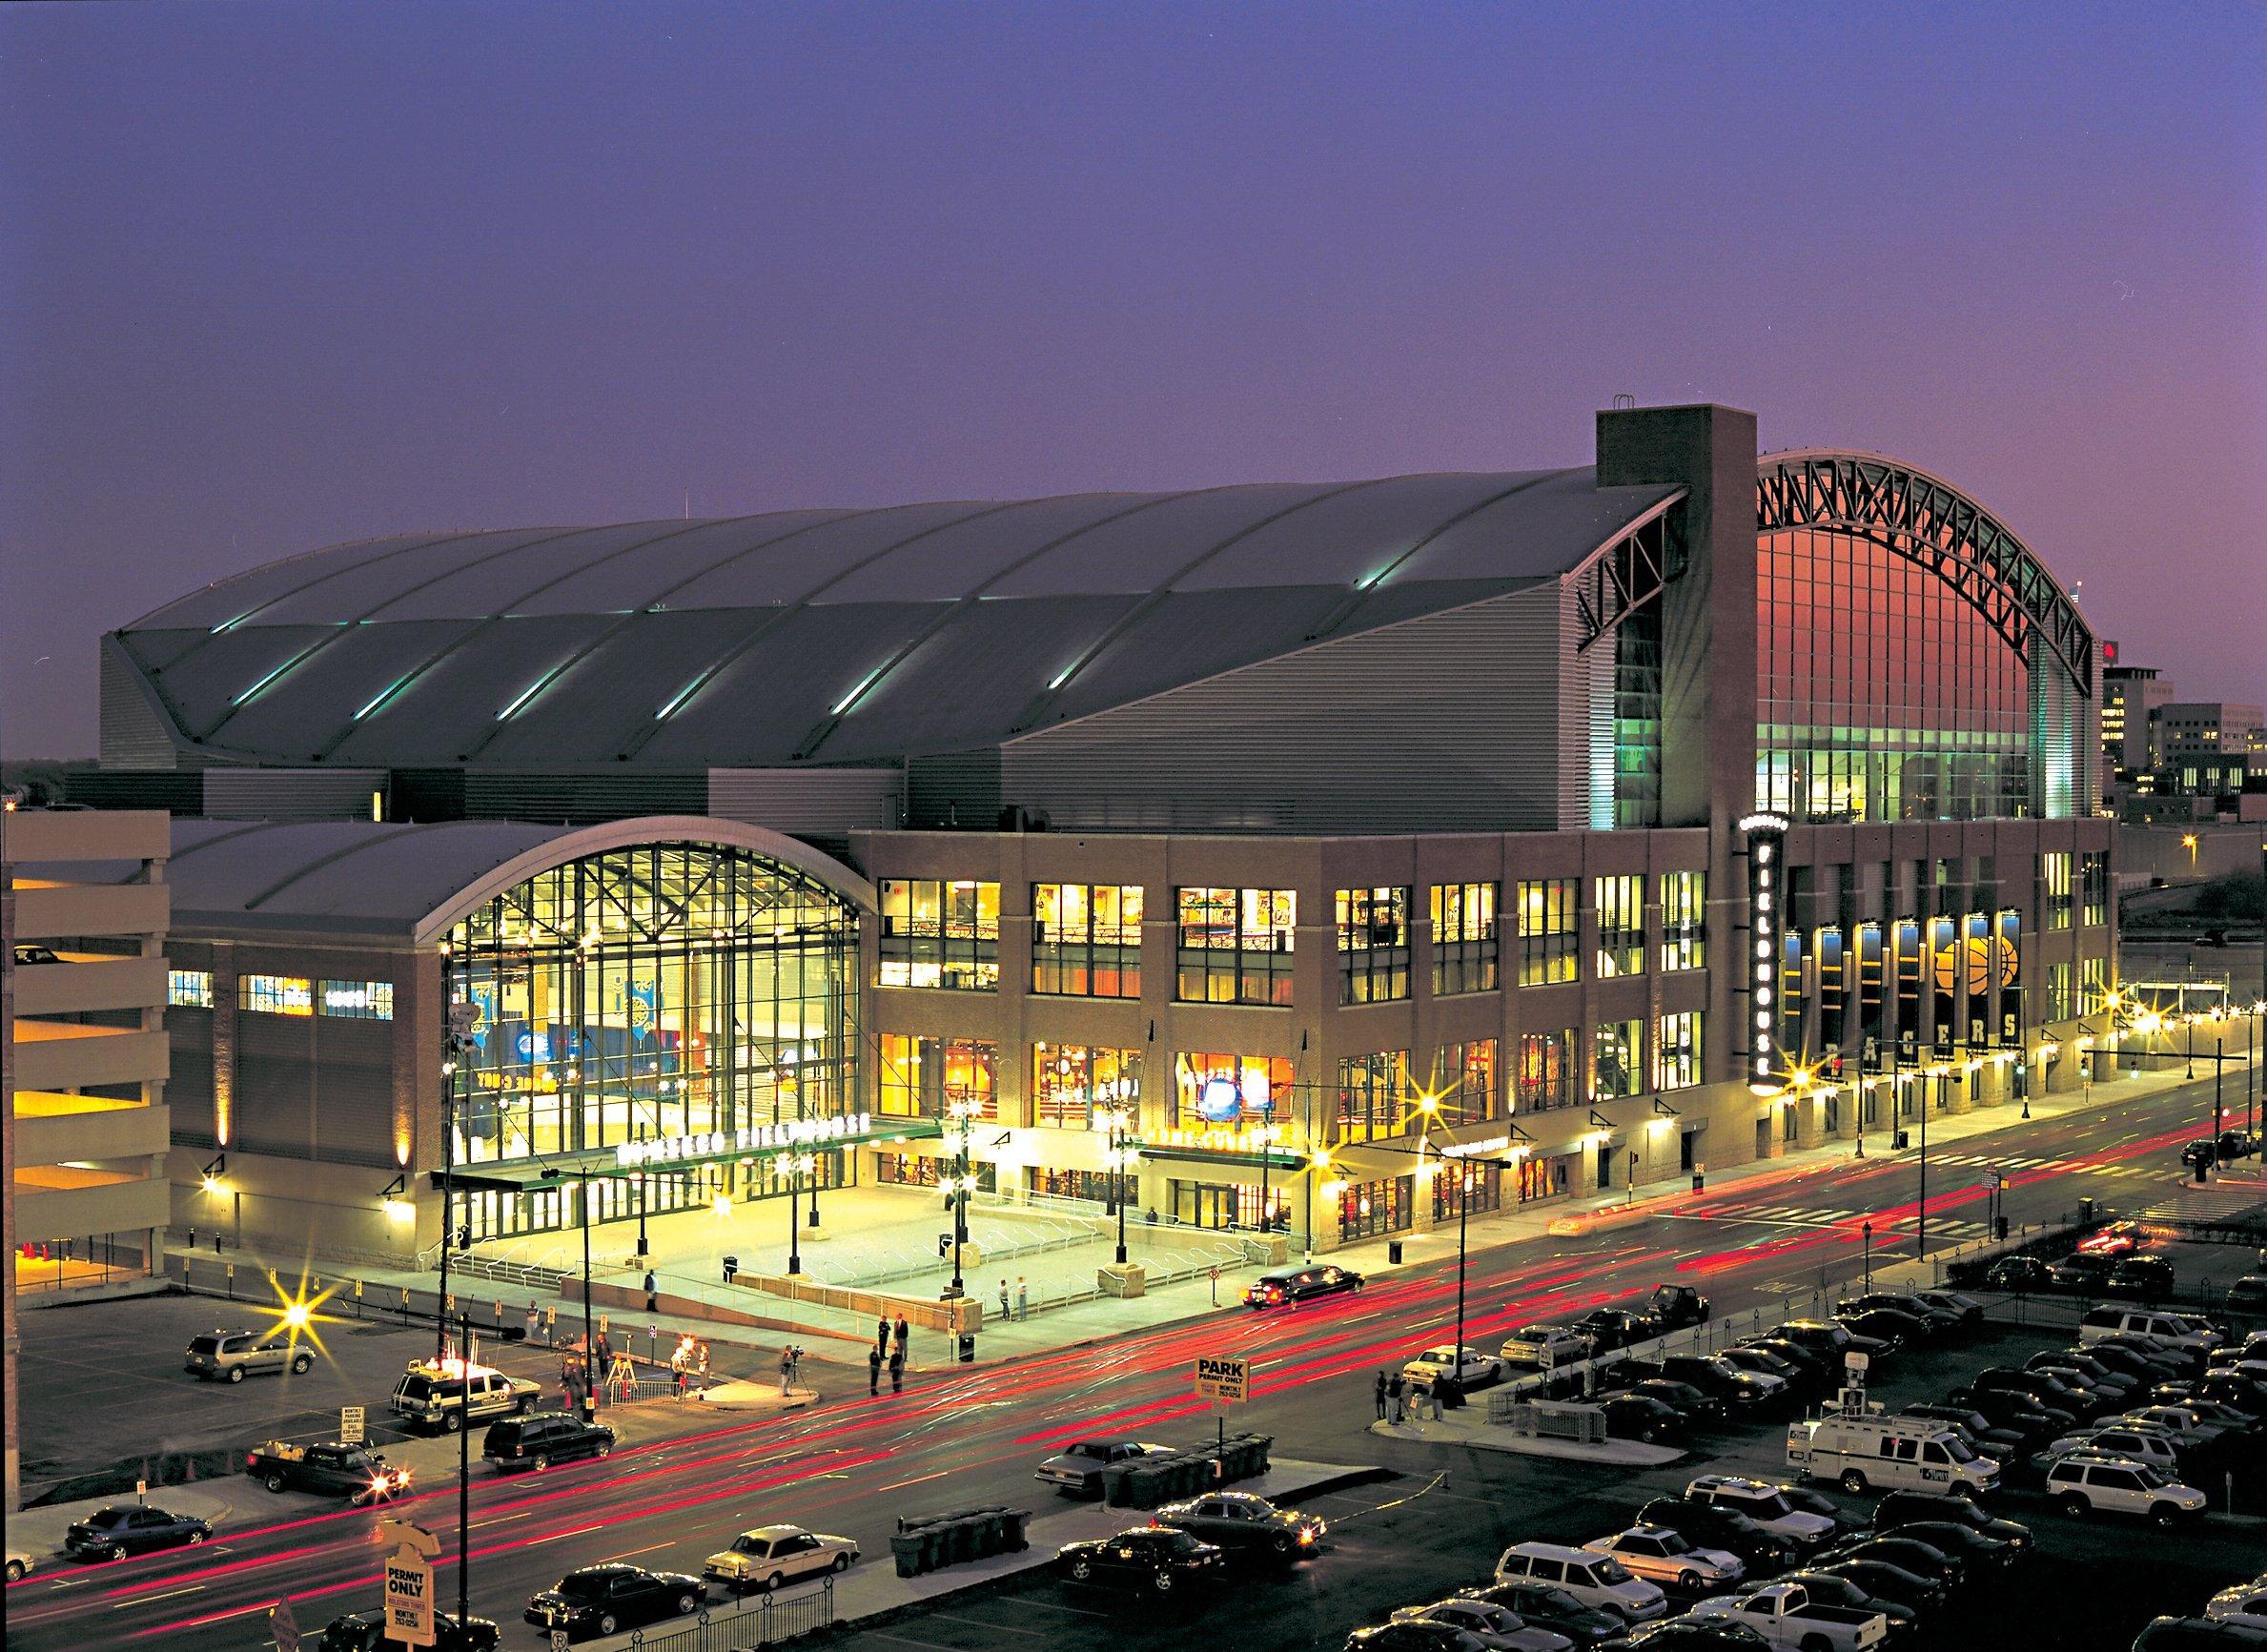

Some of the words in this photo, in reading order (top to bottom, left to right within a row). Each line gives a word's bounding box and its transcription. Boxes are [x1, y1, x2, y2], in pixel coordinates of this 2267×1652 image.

[1199, 1359, 1243, 1377] PARK
[388, 1567, 424, 1583] PERMIT
[389, 1580, 423, 1597] ONLY
